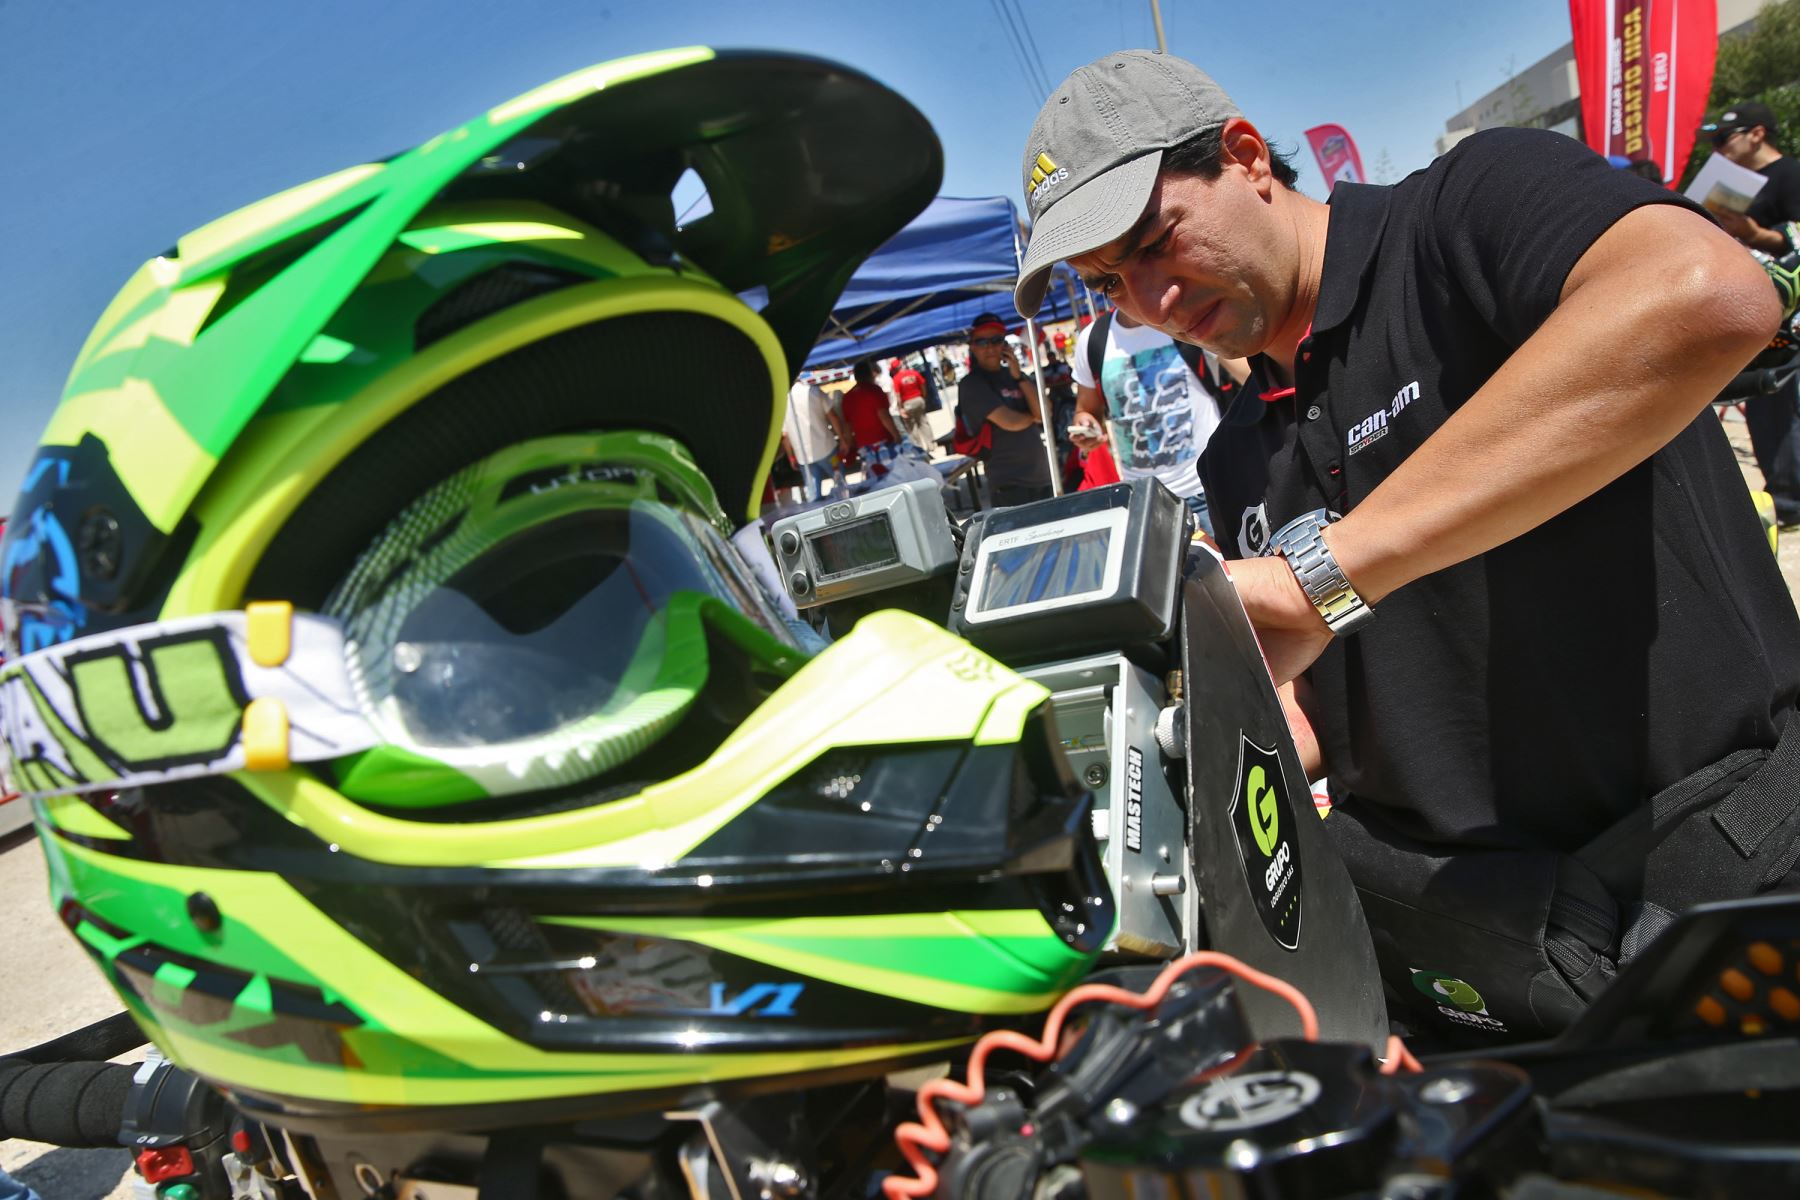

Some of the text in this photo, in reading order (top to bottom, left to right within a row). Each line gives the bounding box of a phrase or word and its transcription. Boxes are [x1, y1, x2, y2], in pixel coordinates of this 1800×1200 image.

[1624, 6, 1642, 63] INCA
[1031, 167, 1069, 208] adidas
[1127, 747, 1142, 851] MASTECH
[1265, 841, 1290, 892] GRUPO
